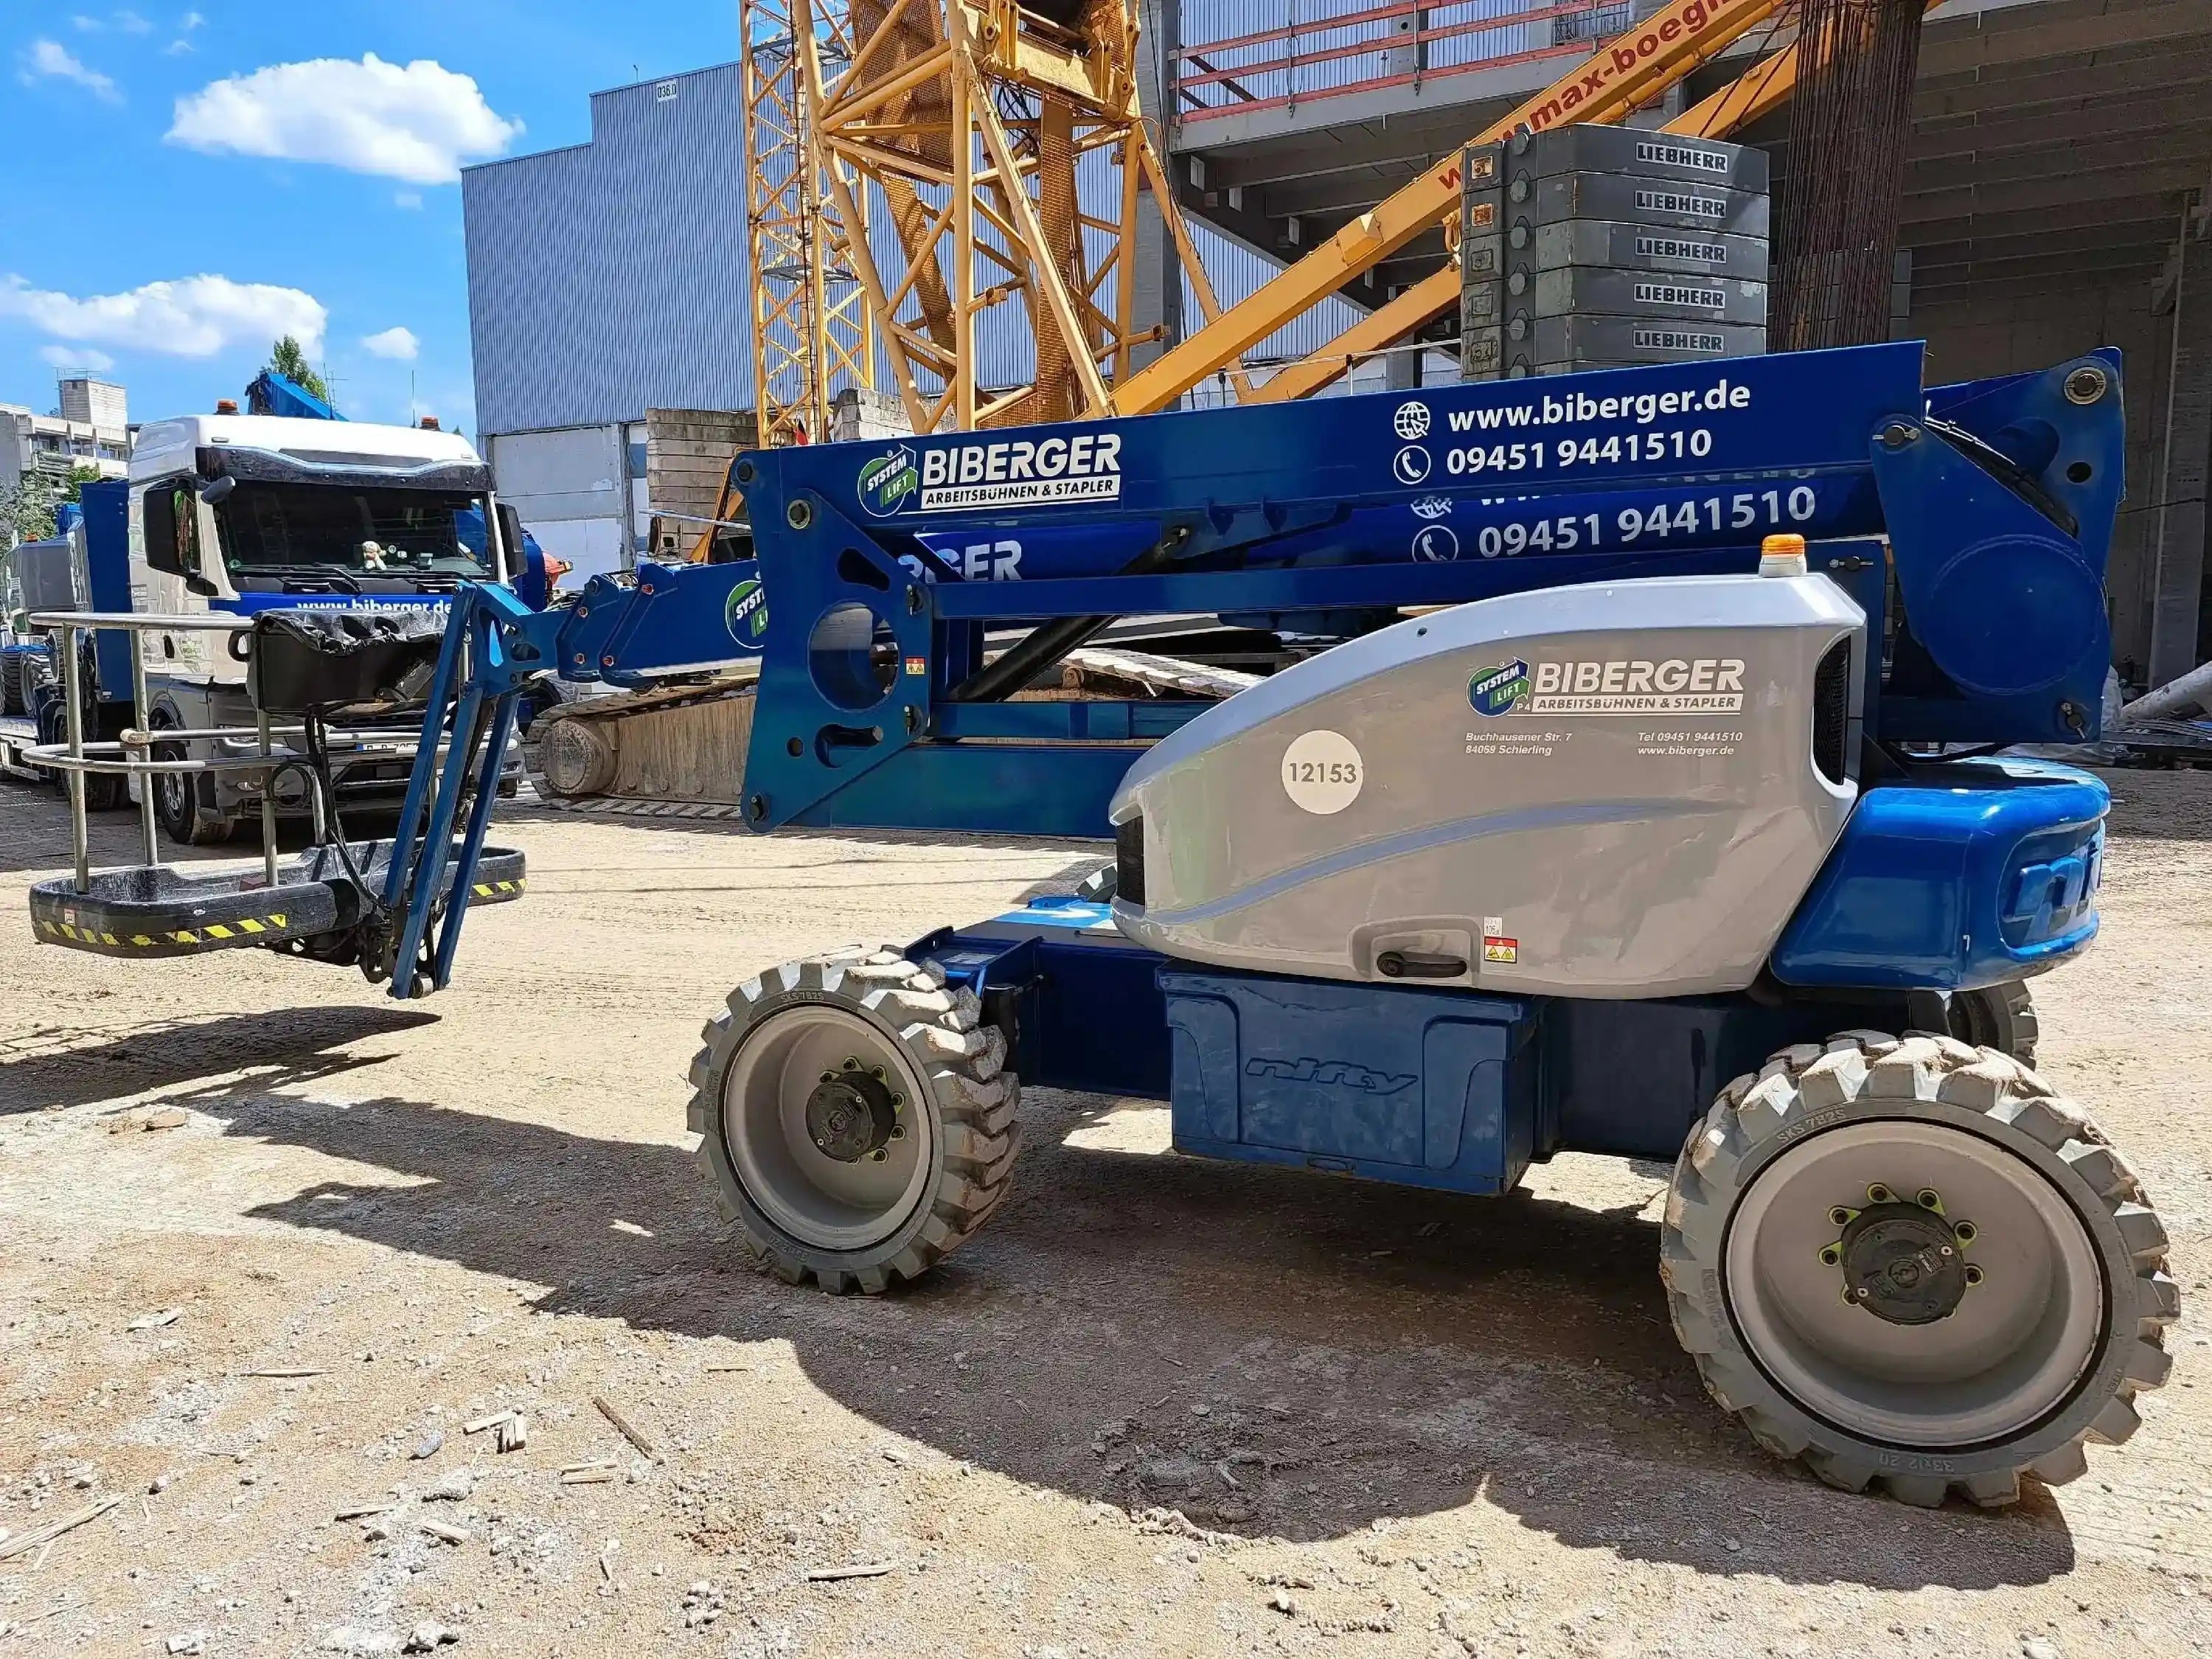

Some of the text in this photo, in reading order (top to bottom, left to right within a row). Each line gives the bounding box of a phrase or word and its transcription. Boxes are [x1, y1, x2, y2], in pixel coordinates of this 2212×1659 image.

[1638, 145, 1726, 171] LIEBHERR
[1635, 192, 1725, 216] LIEBHERR
[1637, 238, 1726, 262] LIEBHERR
[1635, 285, 1724, 307] LIEBHERR
[1635, 332, 1723, 350] LIEBHERR
[1448, 379, 1750, 433] www.biberger.de
[922, 434, 1121, 486] BIBERGER
[1447, 429, 1712, 476] 09451 9441510
[866, 453, 908, 493] SYSTEM
[886, 473, 909, 499] LIFT
[925, 479, 1114, 505] ARBEITSBÜHNEN & STAPLER
[1478, 486, 1817, 557] 09451 9441510
[296, 598, 452, 614] wwwbiberger.de
[736, 588, 762, 620] SYST
[1476, 664, 1520, 695] SYSTEM
[1534, 659, 1745, 693] BIBERGER
[1497, 682, 1520, 701] LIFT
[1537, 696, 1736, 709] ARBEITSBÜHNEN & STAPLER
[1466, 732, 1573, 742] Buchhausener Str. 7
[1638, 731, 1743, 741] Tel 09451 9441510
[1498, 745, 1553, 757] Schierling
[1638, 745, 1734, 757] www.biberger.de
[1289, 762, 1357, 784] 12153
